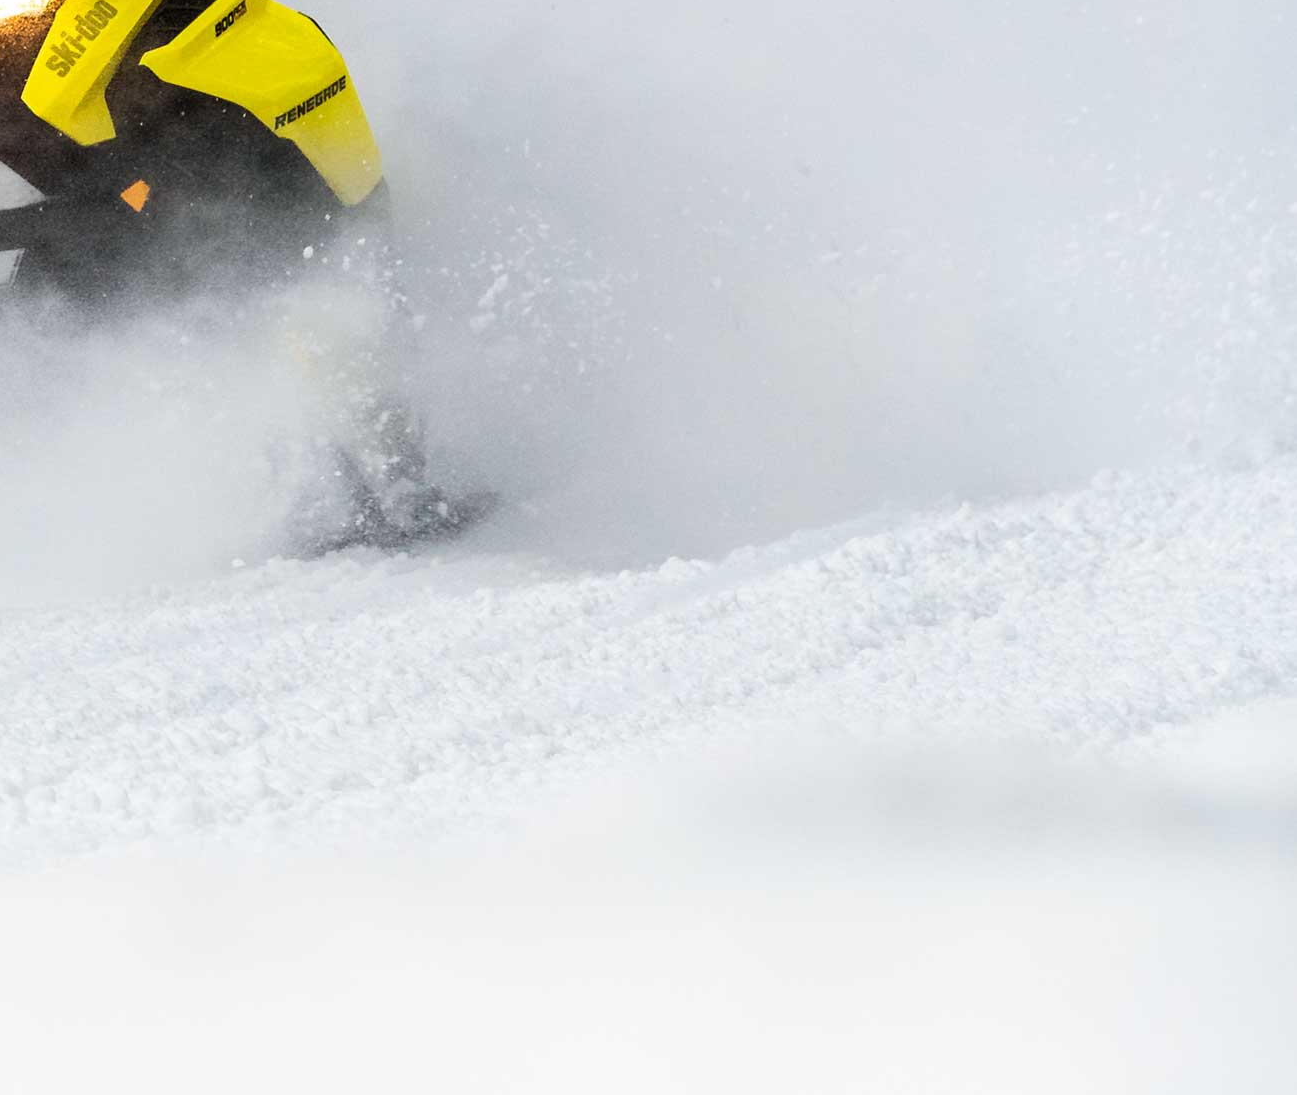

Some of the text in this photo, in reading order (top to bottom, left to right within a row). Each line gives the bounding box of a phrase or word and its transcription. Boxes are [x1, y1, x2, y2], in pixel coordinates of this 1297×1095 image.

[46, 0, 118, 78] ski-doo
[215, 11, 234, 37] 900
[274, 75, 346, 130] RENEGADE
